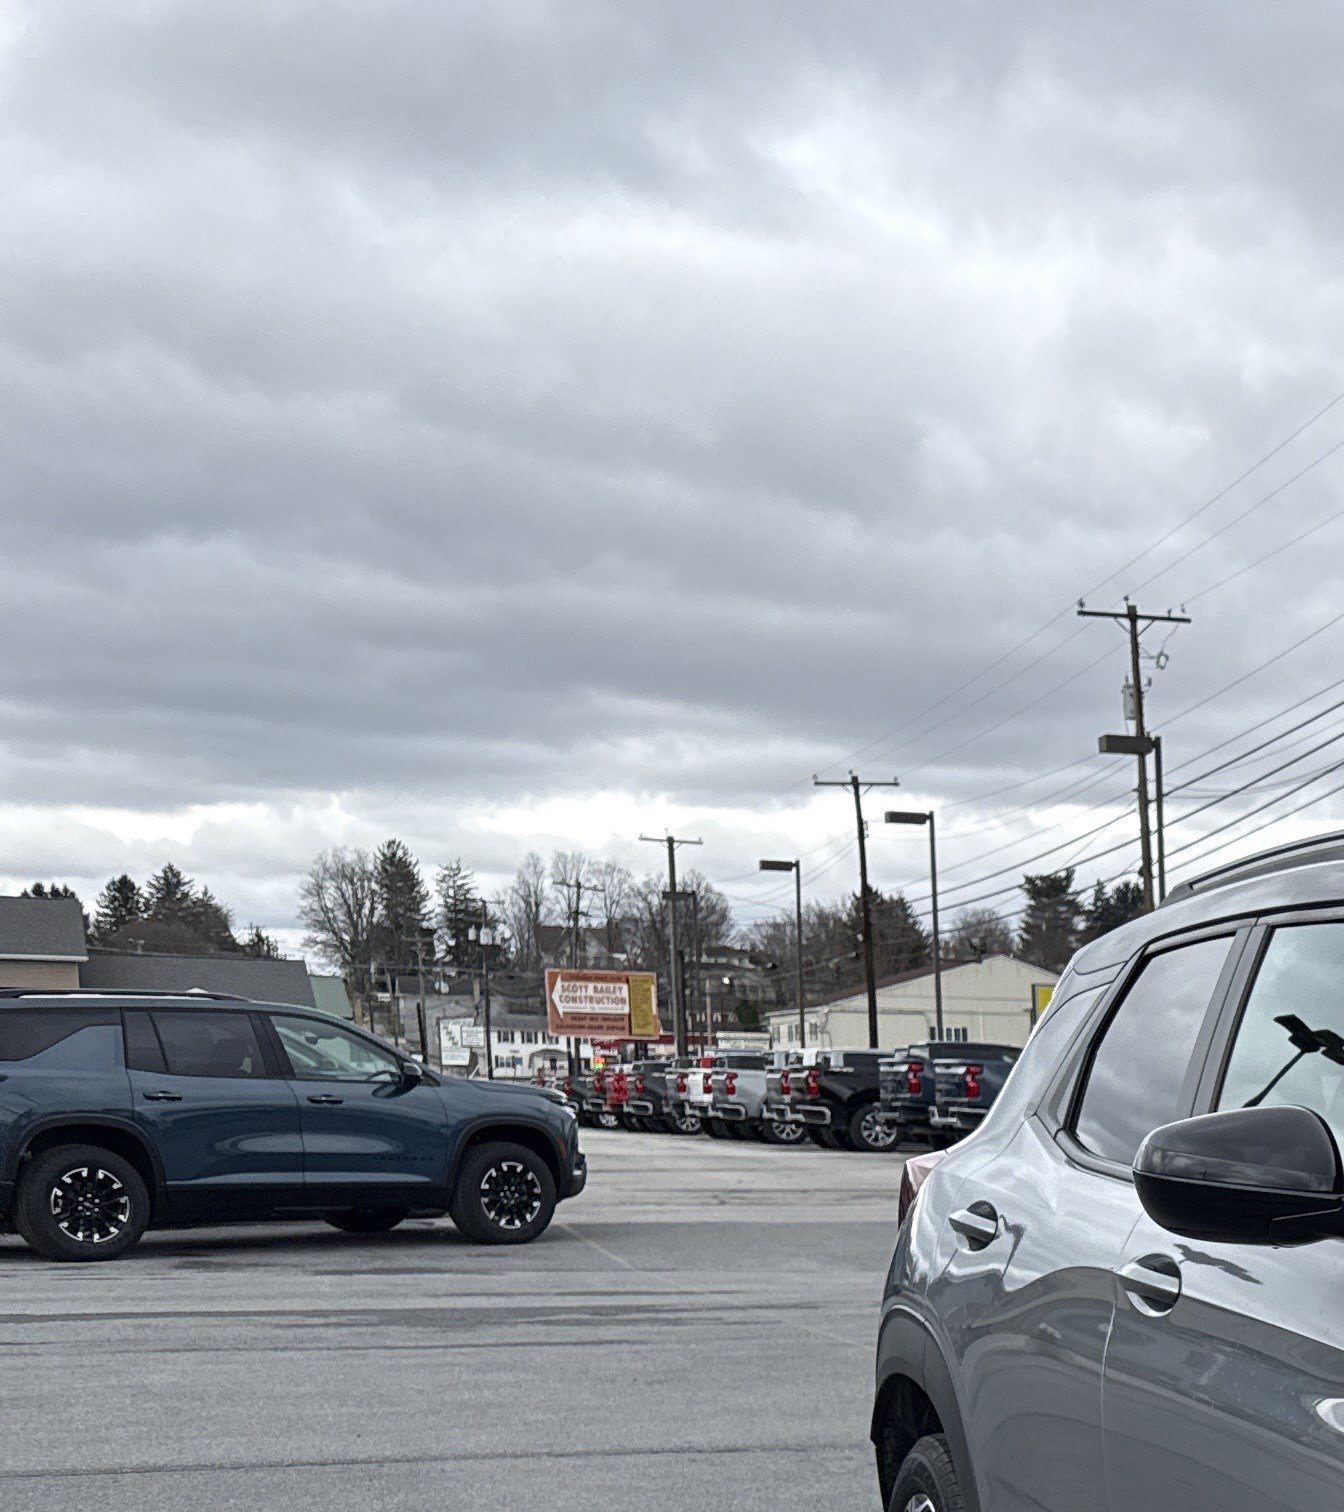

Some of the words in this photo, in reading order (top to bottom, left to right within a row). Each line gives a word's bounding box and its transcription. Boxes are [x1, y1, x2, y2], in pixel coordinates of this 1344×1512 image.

[560, 983, 590, 995] SCOTT
[593, 984, 624, 995] BAILEY
[559, 994, 627, 1006] CONSTRUCTION
